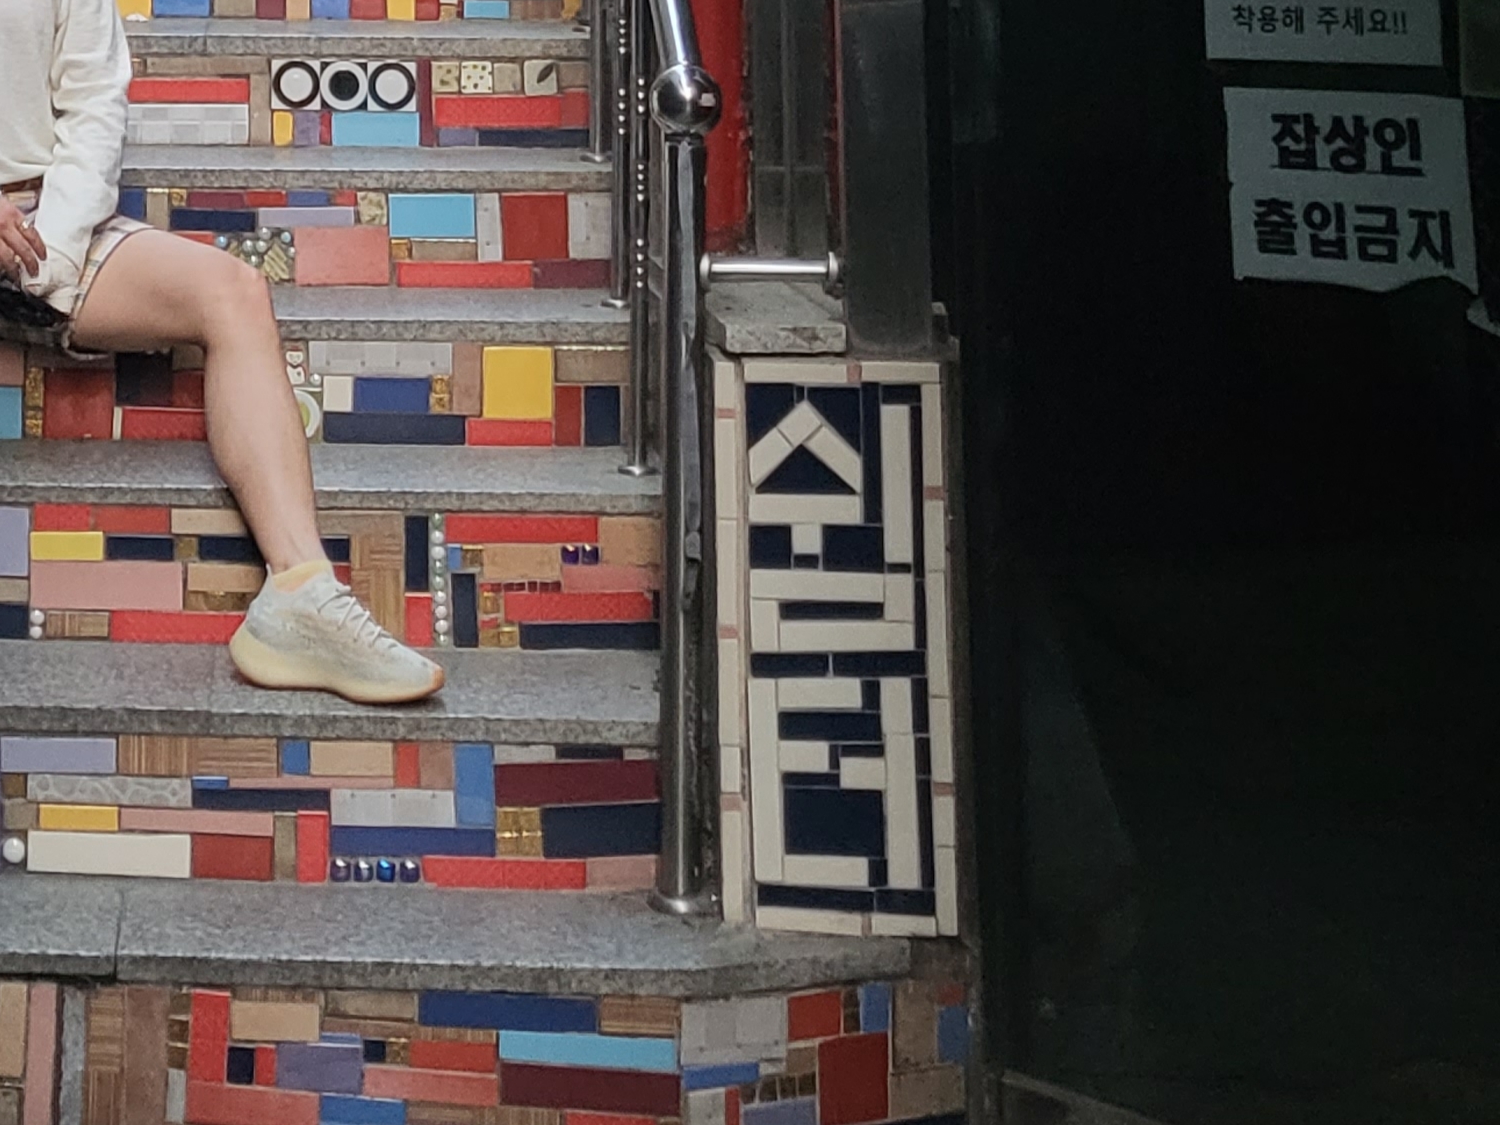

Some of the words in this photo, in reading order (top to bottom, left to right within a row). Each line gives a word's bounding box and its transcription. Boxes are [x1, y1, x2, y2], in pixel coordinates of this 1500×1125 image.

[1231, 4, 1305, 35] 착용해
[1316, 6, 1409, 37] 주세요!!
[1271, 112, 1424, 176] 잡상인
[1253, 198, 1455, 269] 출입금지
